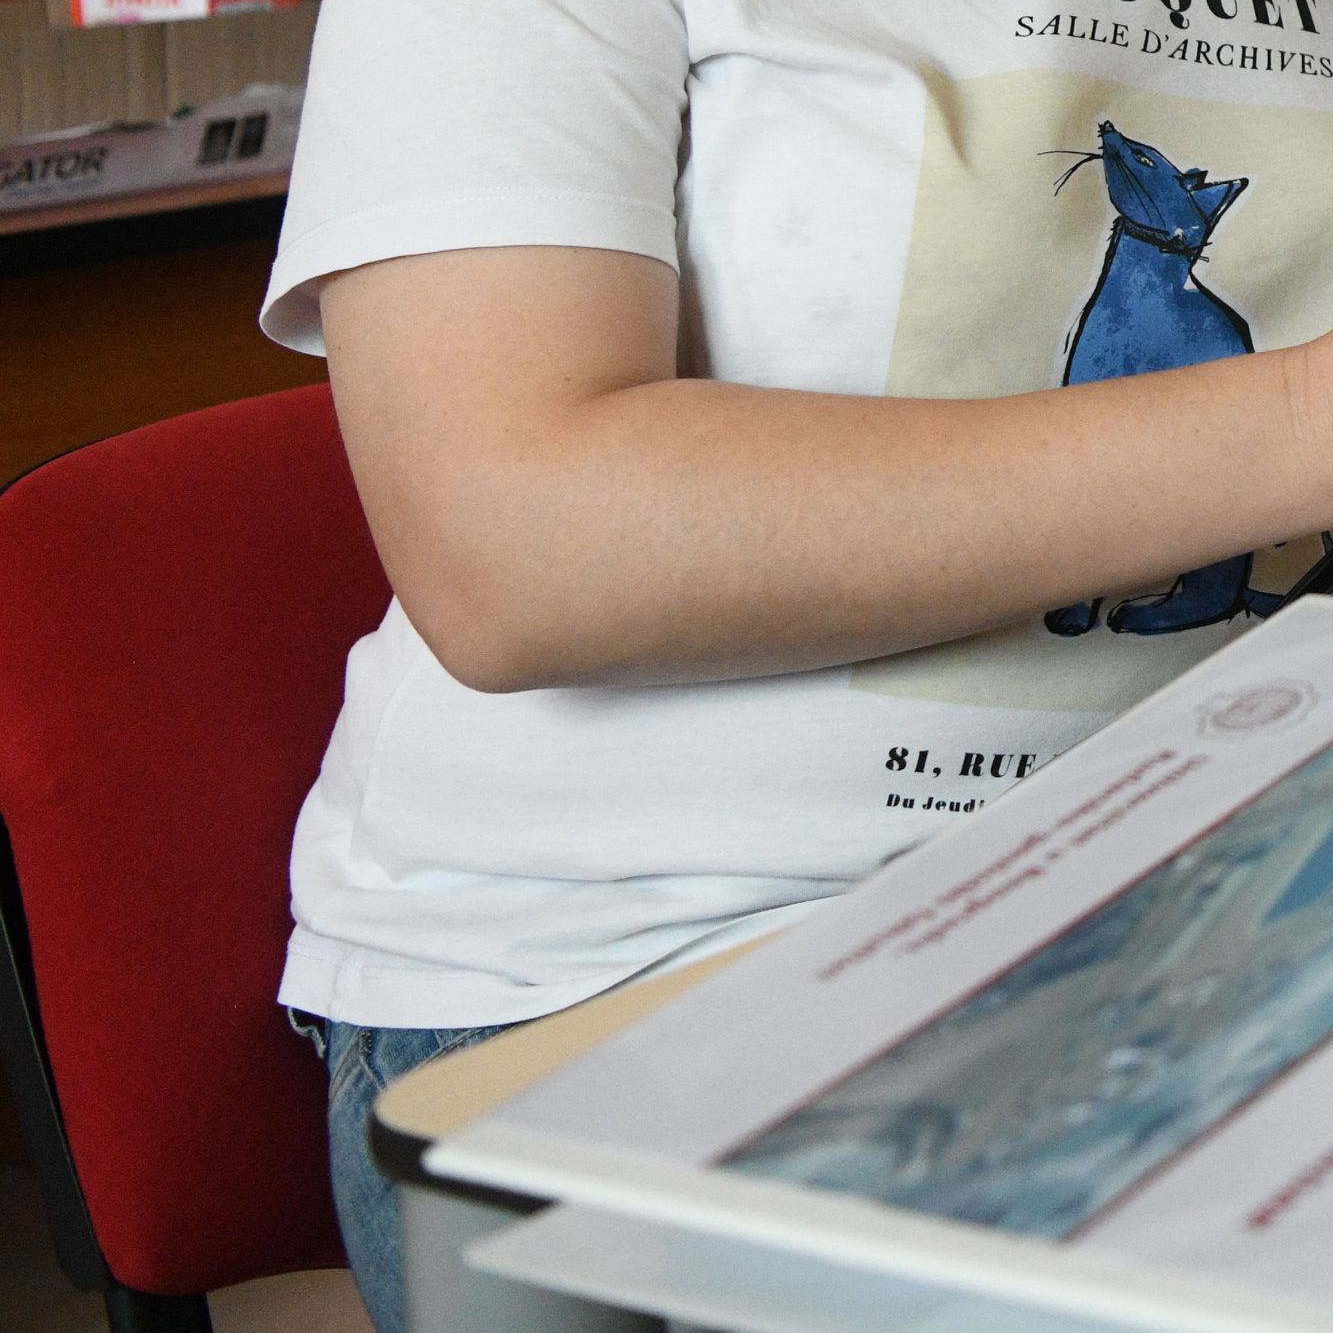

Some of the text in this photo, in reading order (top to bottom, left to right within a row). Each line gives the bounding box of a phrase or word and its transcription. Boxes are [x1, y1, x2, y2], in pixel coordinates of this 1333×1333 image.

[1014, 14, 1130, 50] SALLE
[885, 746, 1038, 779] 81, RUE
[885, 793, 915, 809] Du
